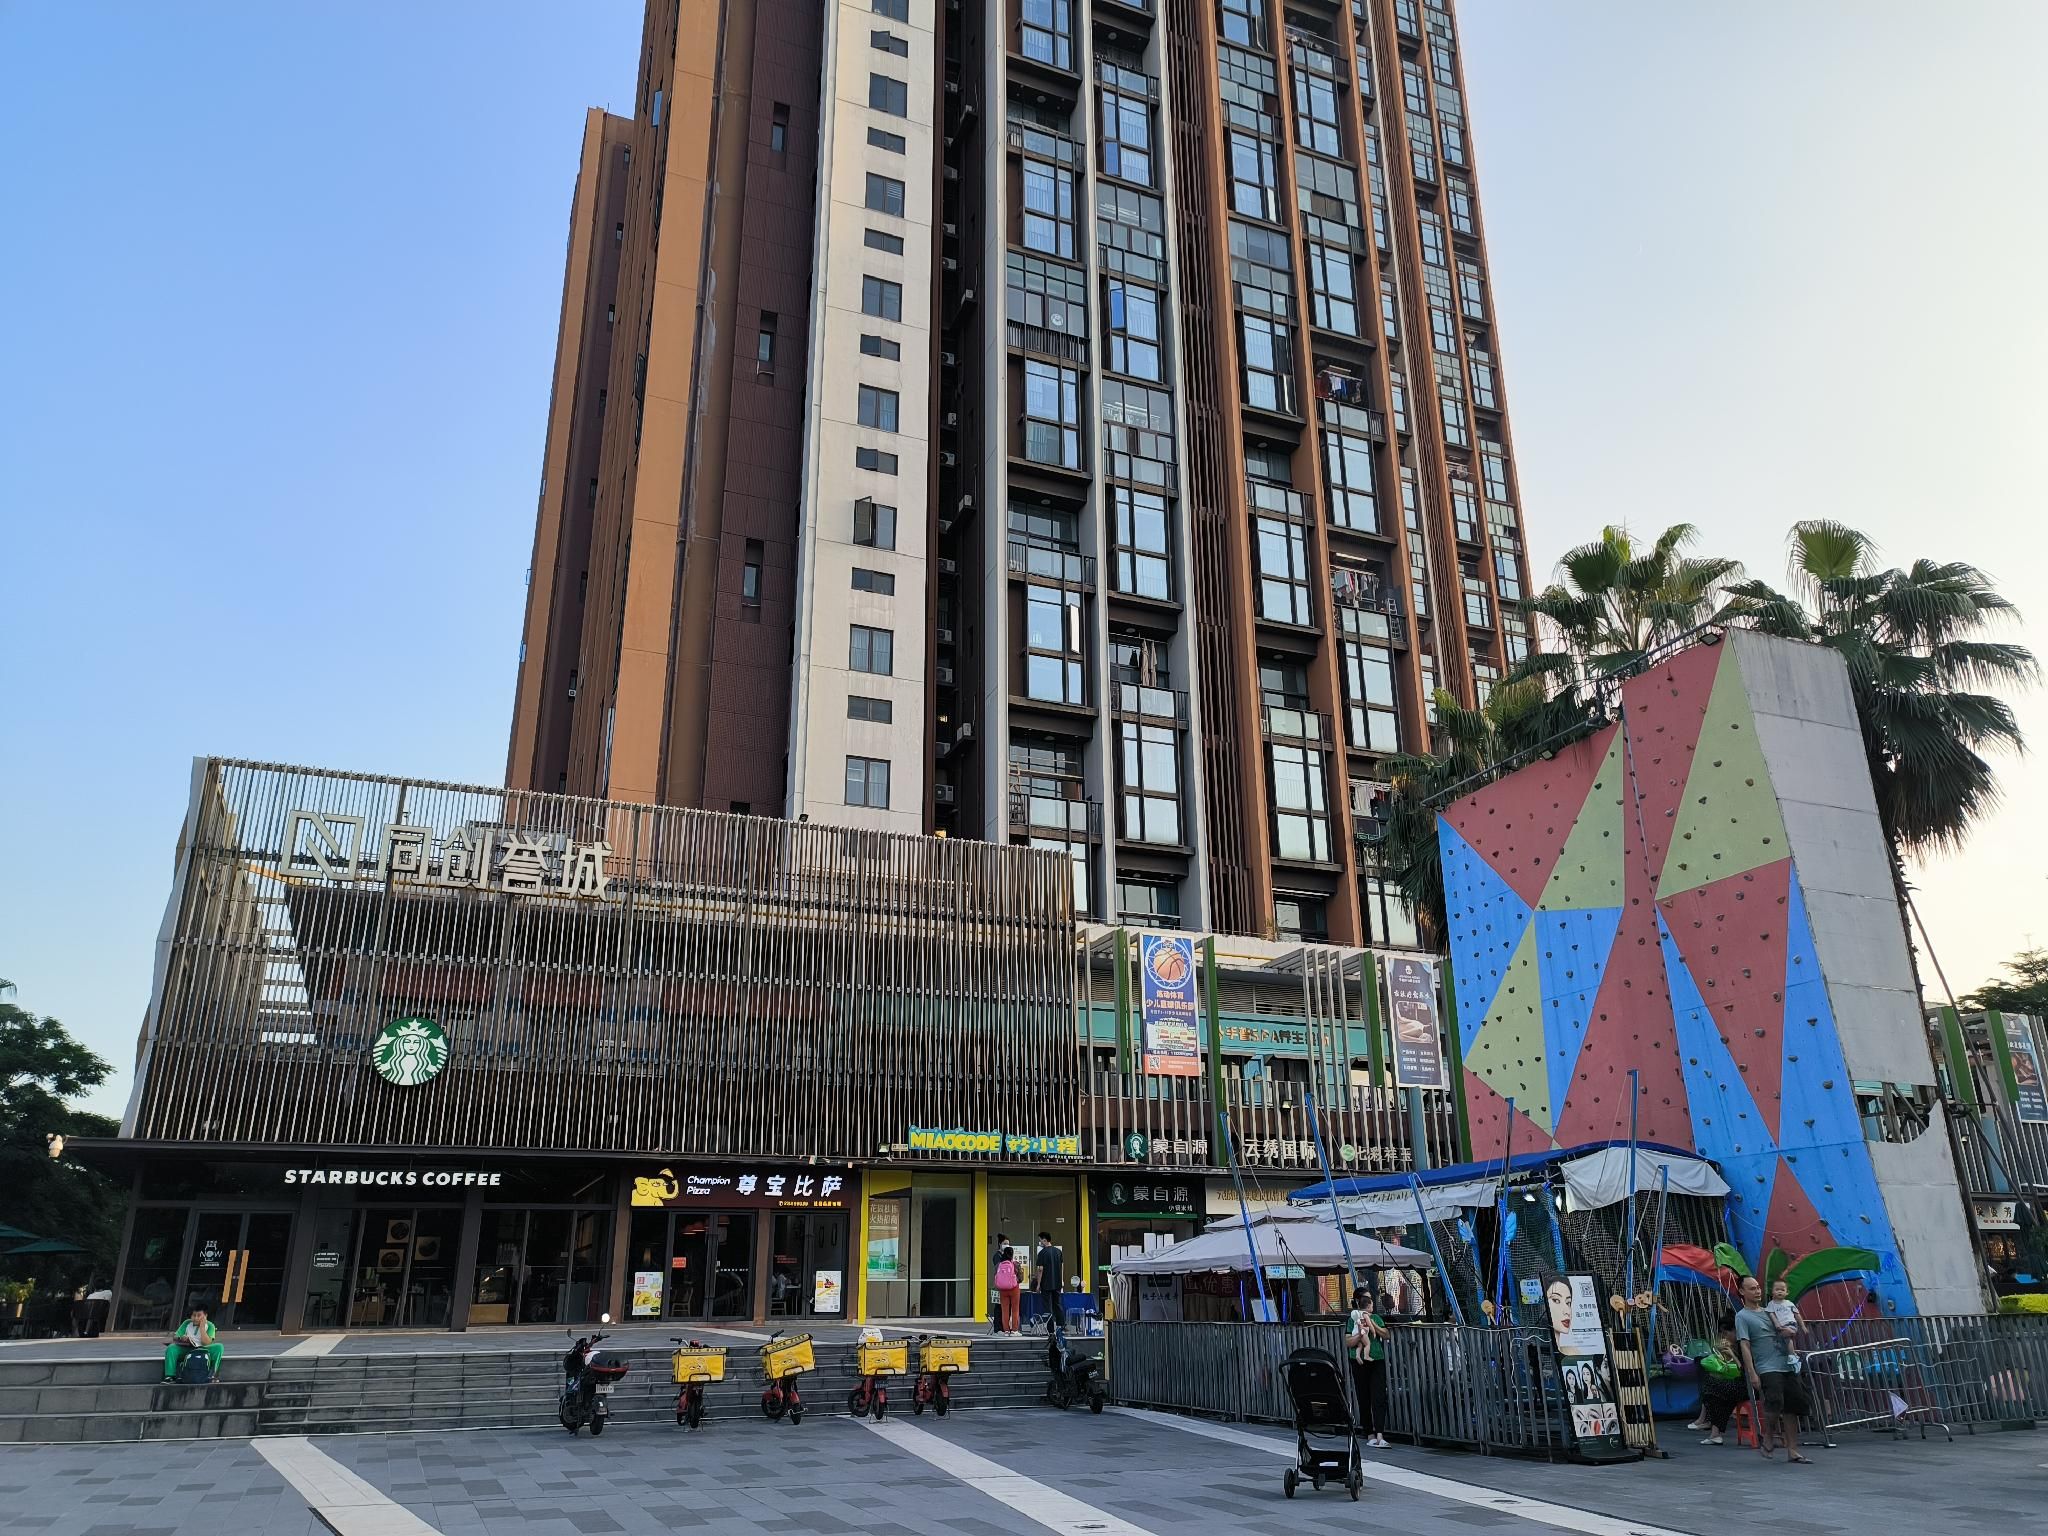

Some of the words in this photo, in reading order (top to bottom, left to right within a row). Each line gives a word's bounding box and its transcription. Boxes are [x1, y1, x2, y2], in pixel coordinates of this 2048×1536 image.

[377, 823, 613, 902] 同创誉城
[910, 1132, 1001, 1152] MIAOCODE
[1006, 1137, 1079, 1154] 妙小程
[1152, 1138, 1208, 1155] 蒙自源
[1244, 1138, 1317, 1161] 云绣国际
[1355, 1145, 1413, 1162] 七彩祥玉
[284, 1169, 417, 1187] STARBUCKS
[422, 1172, 502, 1187] COFFEE
[687, 1175, 731, 1186] Champion
[735, 1174, 843, 1197] 尊宝比萨
[686, 1185, 711, 1195] Pizza
[1133, 1185, 1189, 1202] 蒙自源
